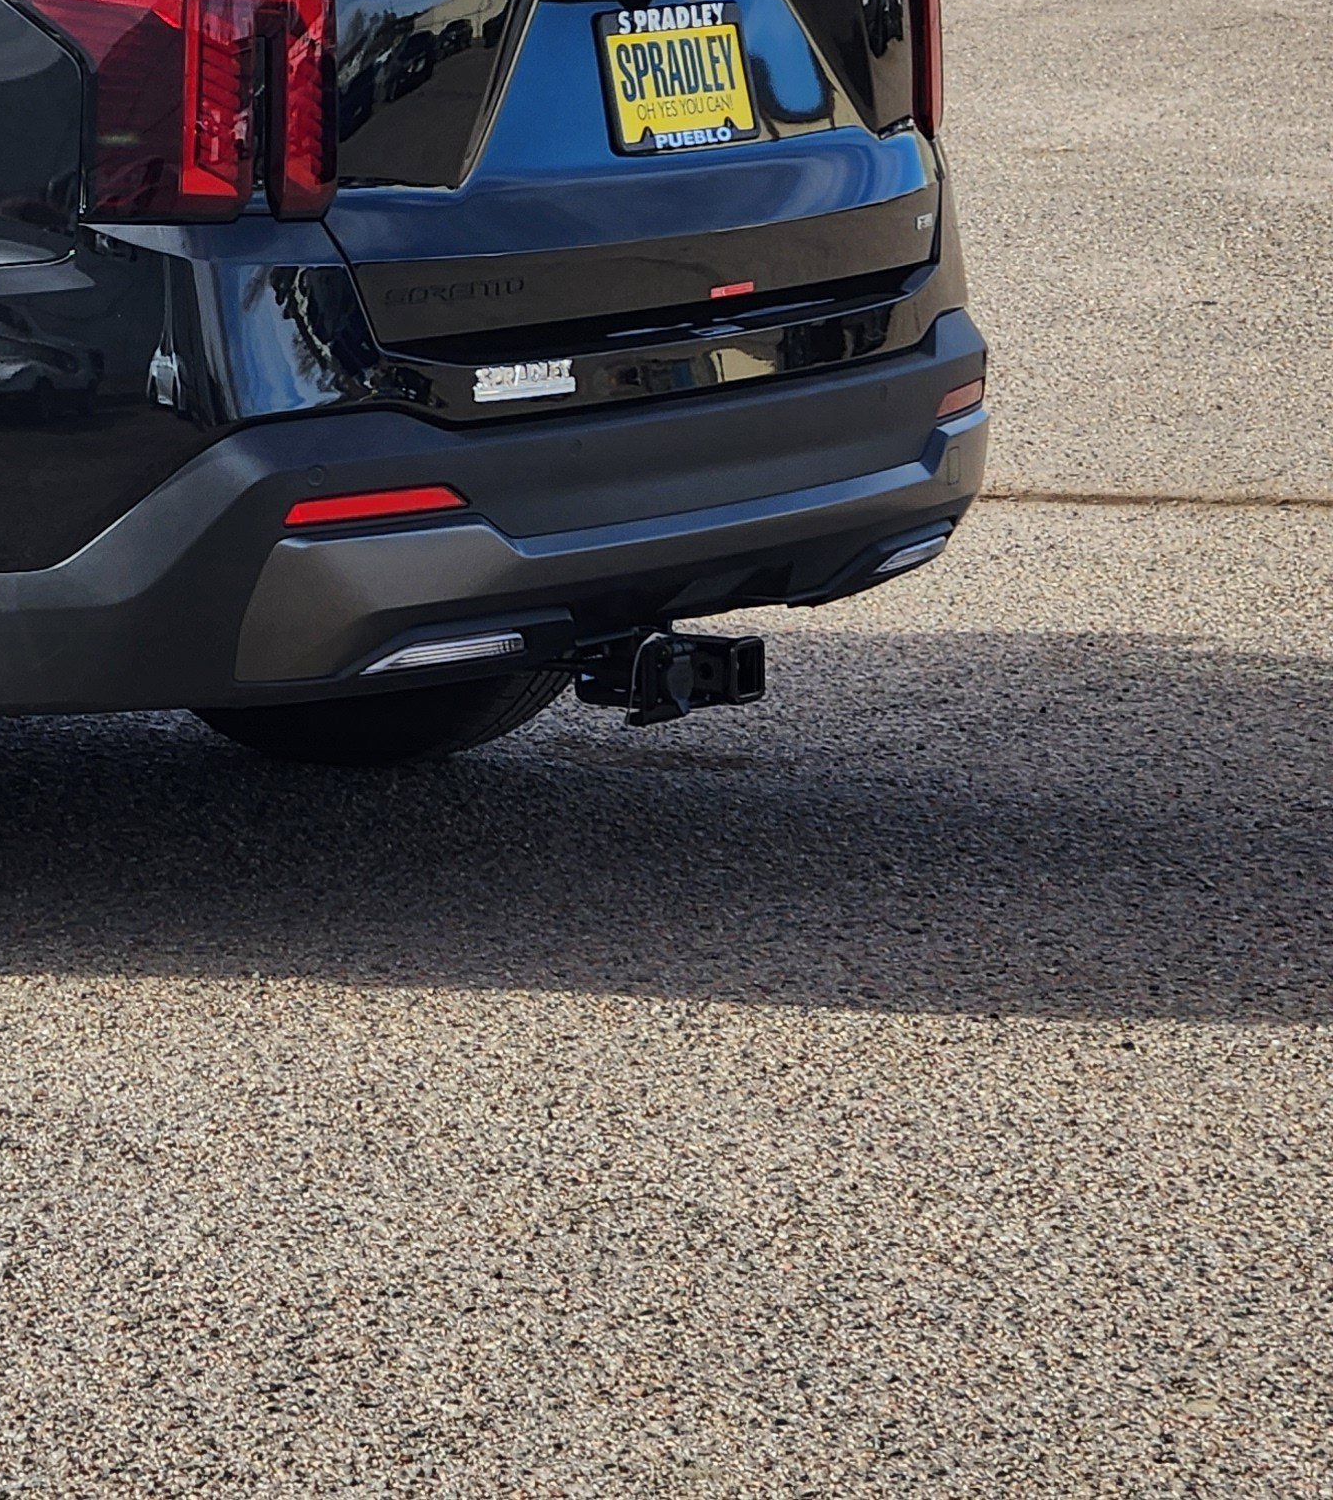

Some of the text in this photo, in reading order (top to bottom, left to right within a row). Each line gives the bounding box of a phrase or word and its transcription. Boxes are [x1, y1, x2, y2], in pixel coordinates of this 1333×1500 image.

[615, 33, 736, 103] SPRADLEY
[636, 93, 734, 120] OH YES YOU CAN!
[654, 126, 733, 149] PUEBLO
